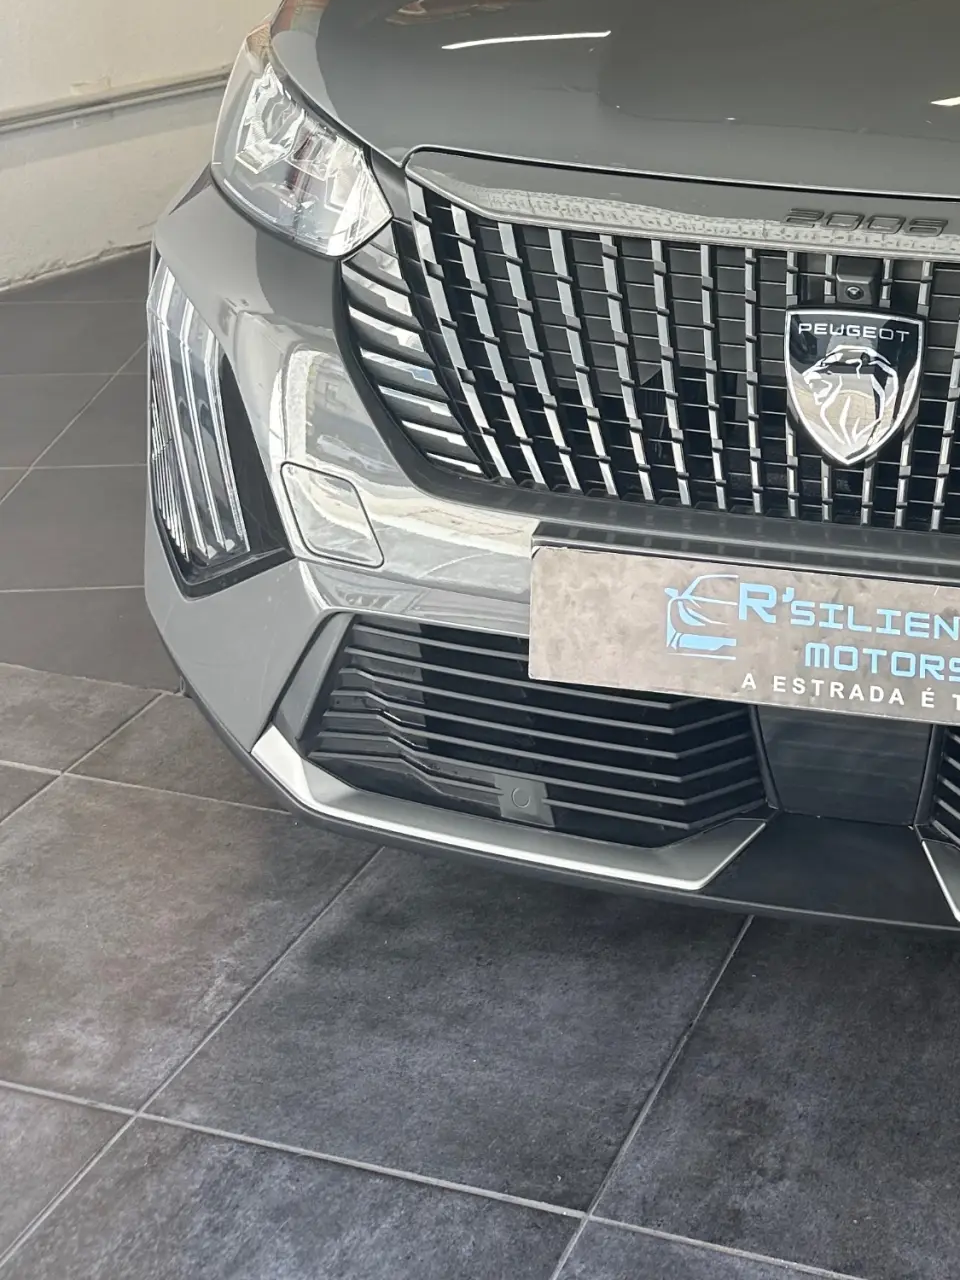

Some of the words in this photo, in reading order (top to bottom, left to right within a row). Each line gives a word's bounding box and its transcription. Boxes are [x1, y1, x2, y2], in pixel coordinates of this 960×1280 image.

[785, 208, 949, 237] 2008
[798, 322, 910, 342] PEUGEOT
[741, 673, 757, 689] A
[773, 675, 905, 706] ESTRADA
[921, 687, 935, 708] É
